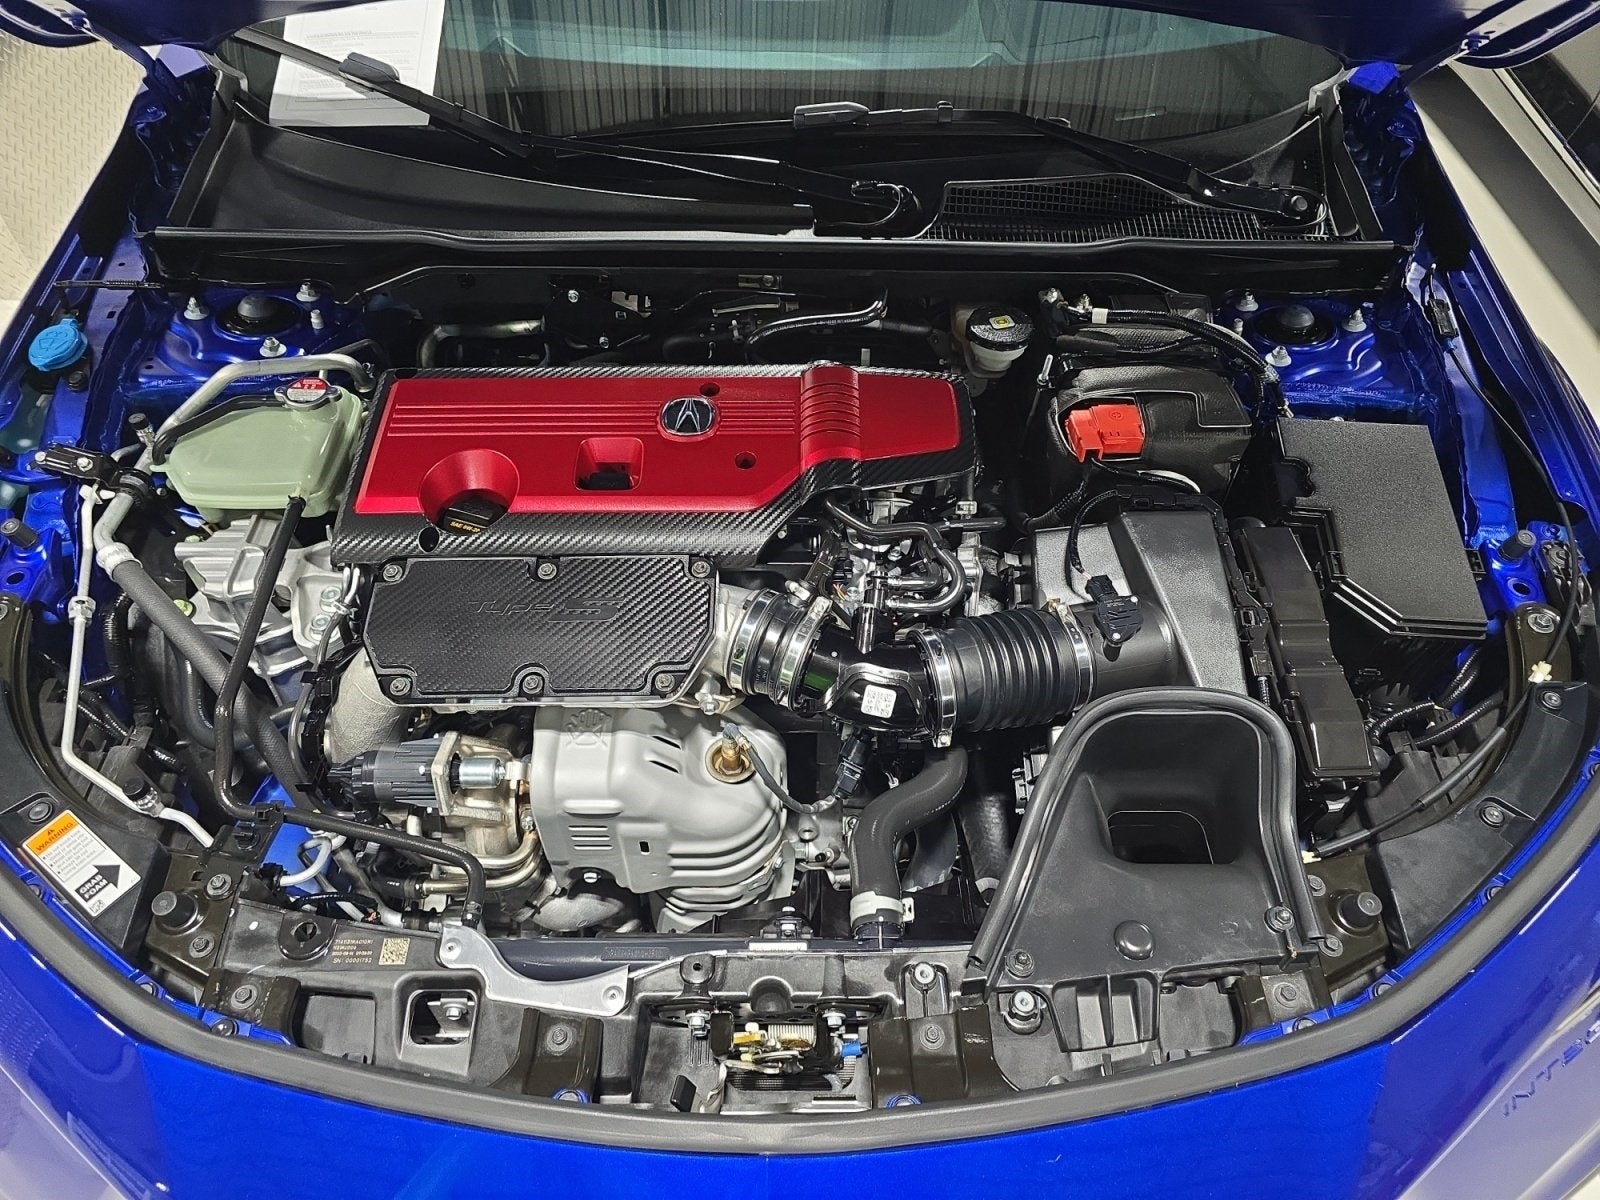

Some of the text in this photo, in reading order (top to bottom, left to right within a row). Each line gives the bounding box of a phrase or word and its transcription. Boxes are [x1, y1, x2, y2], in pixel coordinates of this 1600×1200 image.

[449, 521, 462, 529] SAE
[467, 597, 626, 622] Type S
[36, 821, 74, 851] WARNING
[79, 873, 103, 894] GRAB
[84, 878, 108, 899] FOAM
